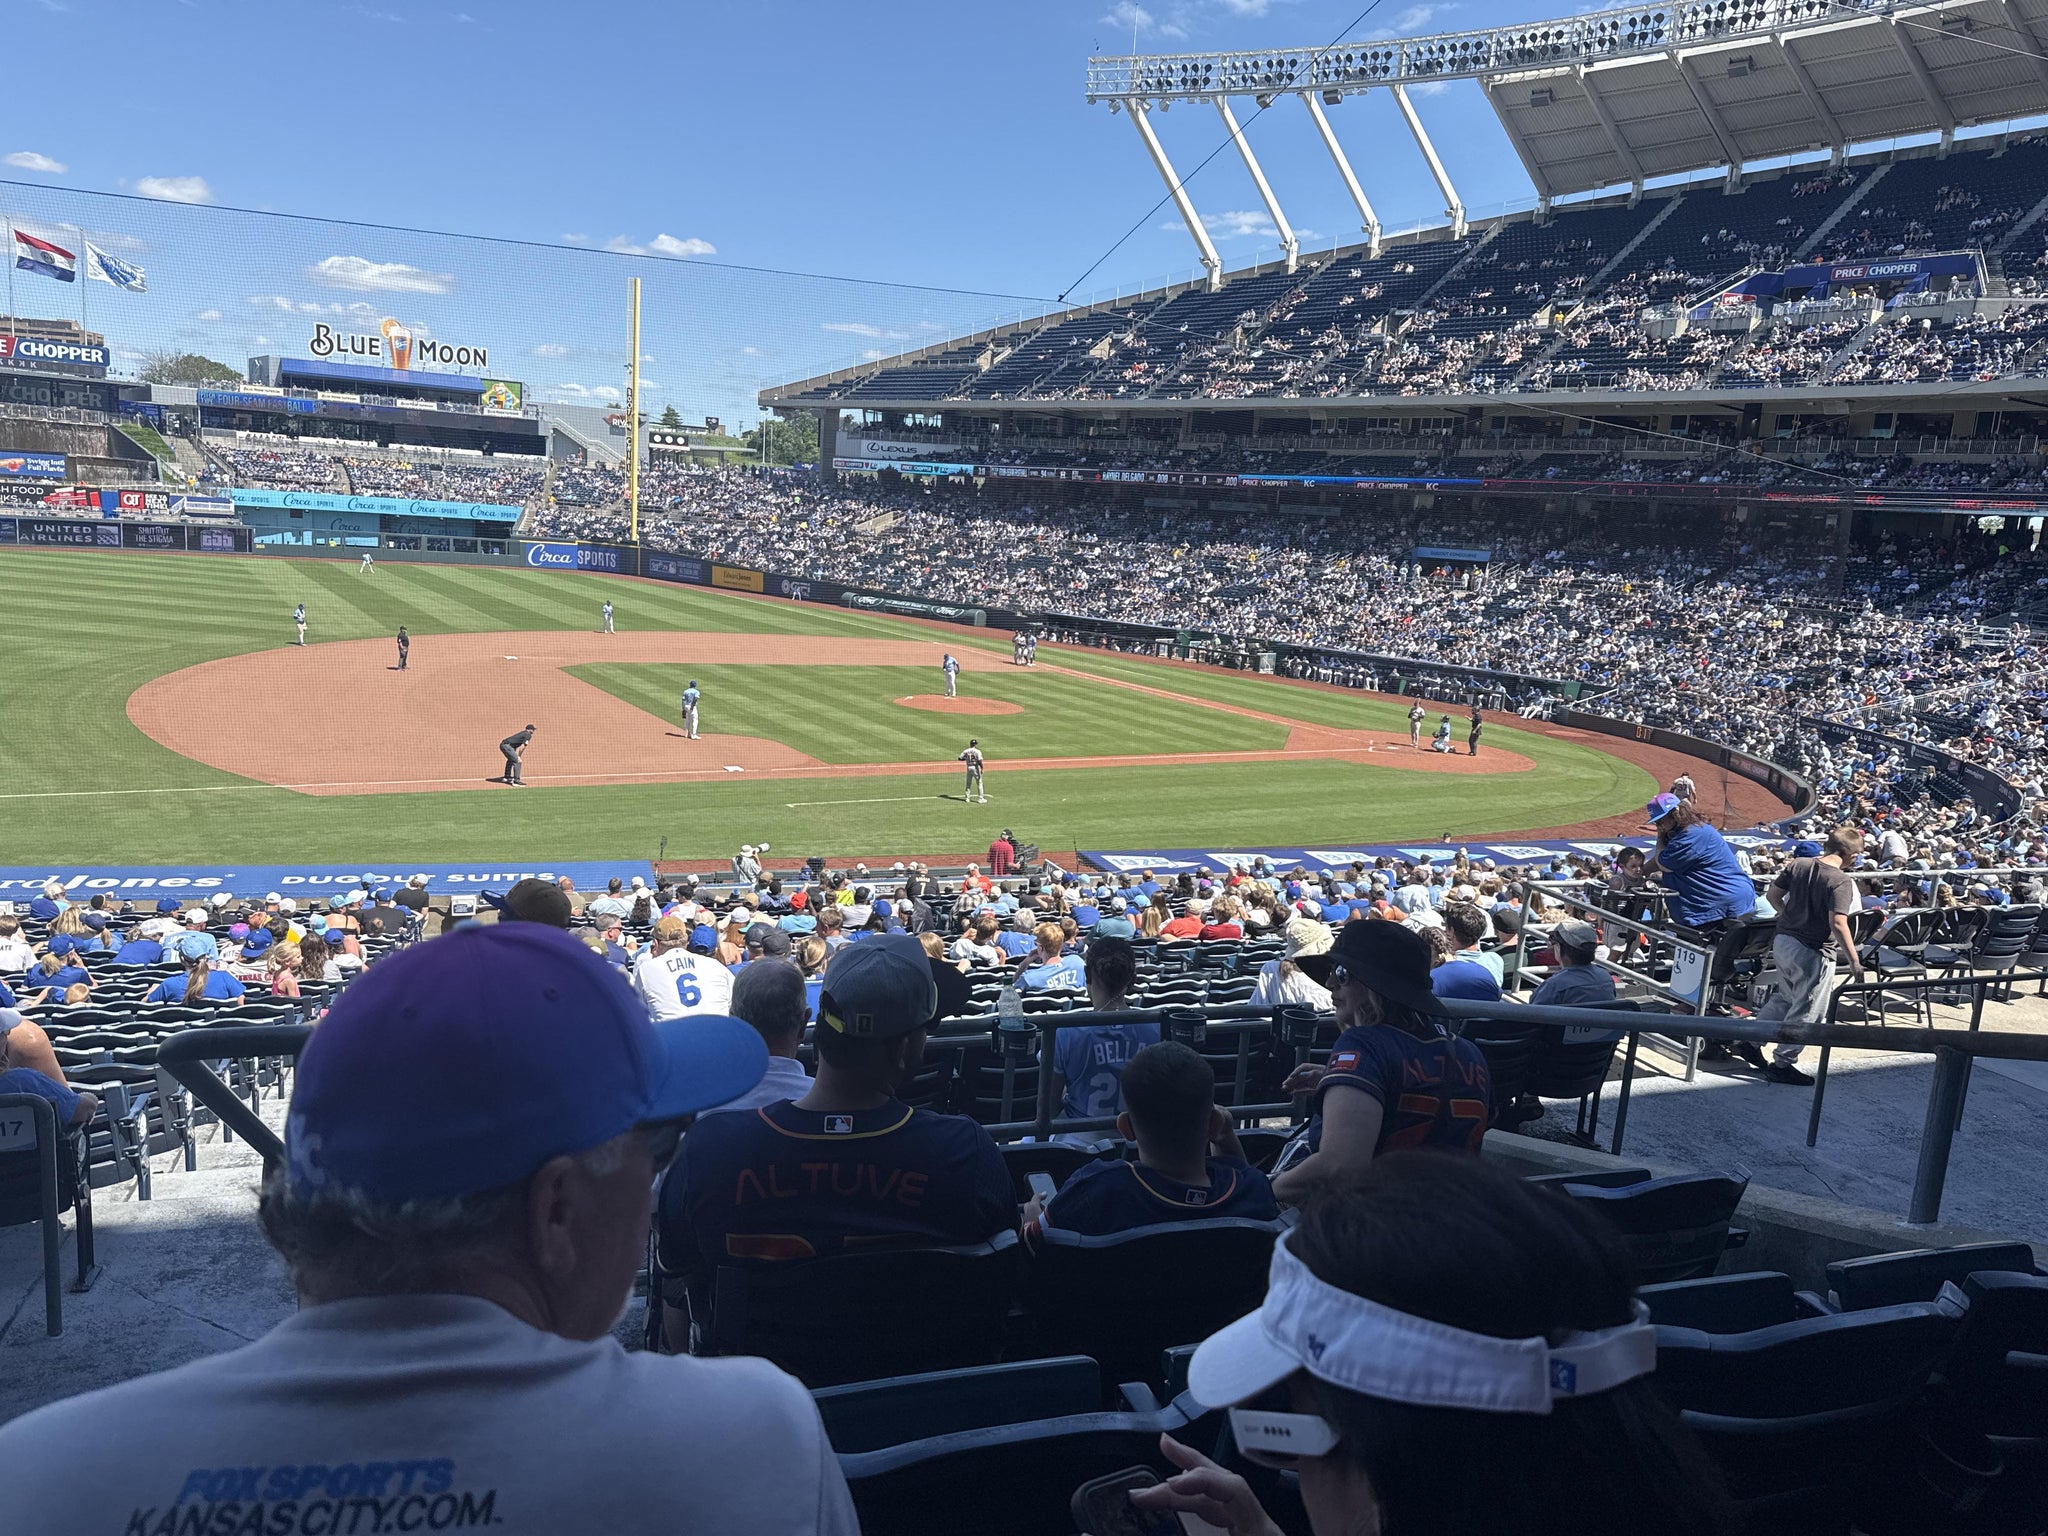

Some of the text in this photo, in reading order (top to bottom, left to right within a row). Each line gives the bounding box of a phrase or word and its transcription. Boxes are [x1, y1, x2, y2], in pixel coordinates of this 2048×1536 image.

[1835, 263, 1917, 278] PRICE CHOPPER
[310, 323, 487, 367] BLUE MOON
[19, 342, 103, 363] CHOPPER
[9, 386, 102, 407] CHOPER
[881, 445, 917, 453] LEXUS
[26, 458, 50, 467] Swing
[12, 486, 43, 495] FOOD
[1304, 480, 1315, 488] KC
[1356, 482, 1439, 491] PRICE CHOPPER KC
[123, 494, 140, 506] QT
[283, 493, 311, 506] Circa
[347, 498, 375, 510] Circa
[409, 501, 437, 514] Circa
[470, 505, 497, 517] Circa
[34, 524, 92, 533] UNITED
[20, 533, 92, 543] AIRLINES
[148, 535, 174, 543] STIGMA
[528, 544, 617, 568] Circa SPORTS
[935, 606, 958, 616] Ford
[1831, 726, 1872, 742] CROWN CLUB
[59, 875, 224, 890] Jones
[446, 872, 556, 882] SUITES
[1676, 947, 1696, 965] 119
[666, 957, 695, 973] CAIN
[1046, 970, 1077, 988] PEREZ
[675, 972, 702, 1008] 6
[1402, 1056, 1488, 1094] ALTVE
[1087, 1072, 1118, 1117] 2
[736, 1162, 928, 1207] ALTUVE
